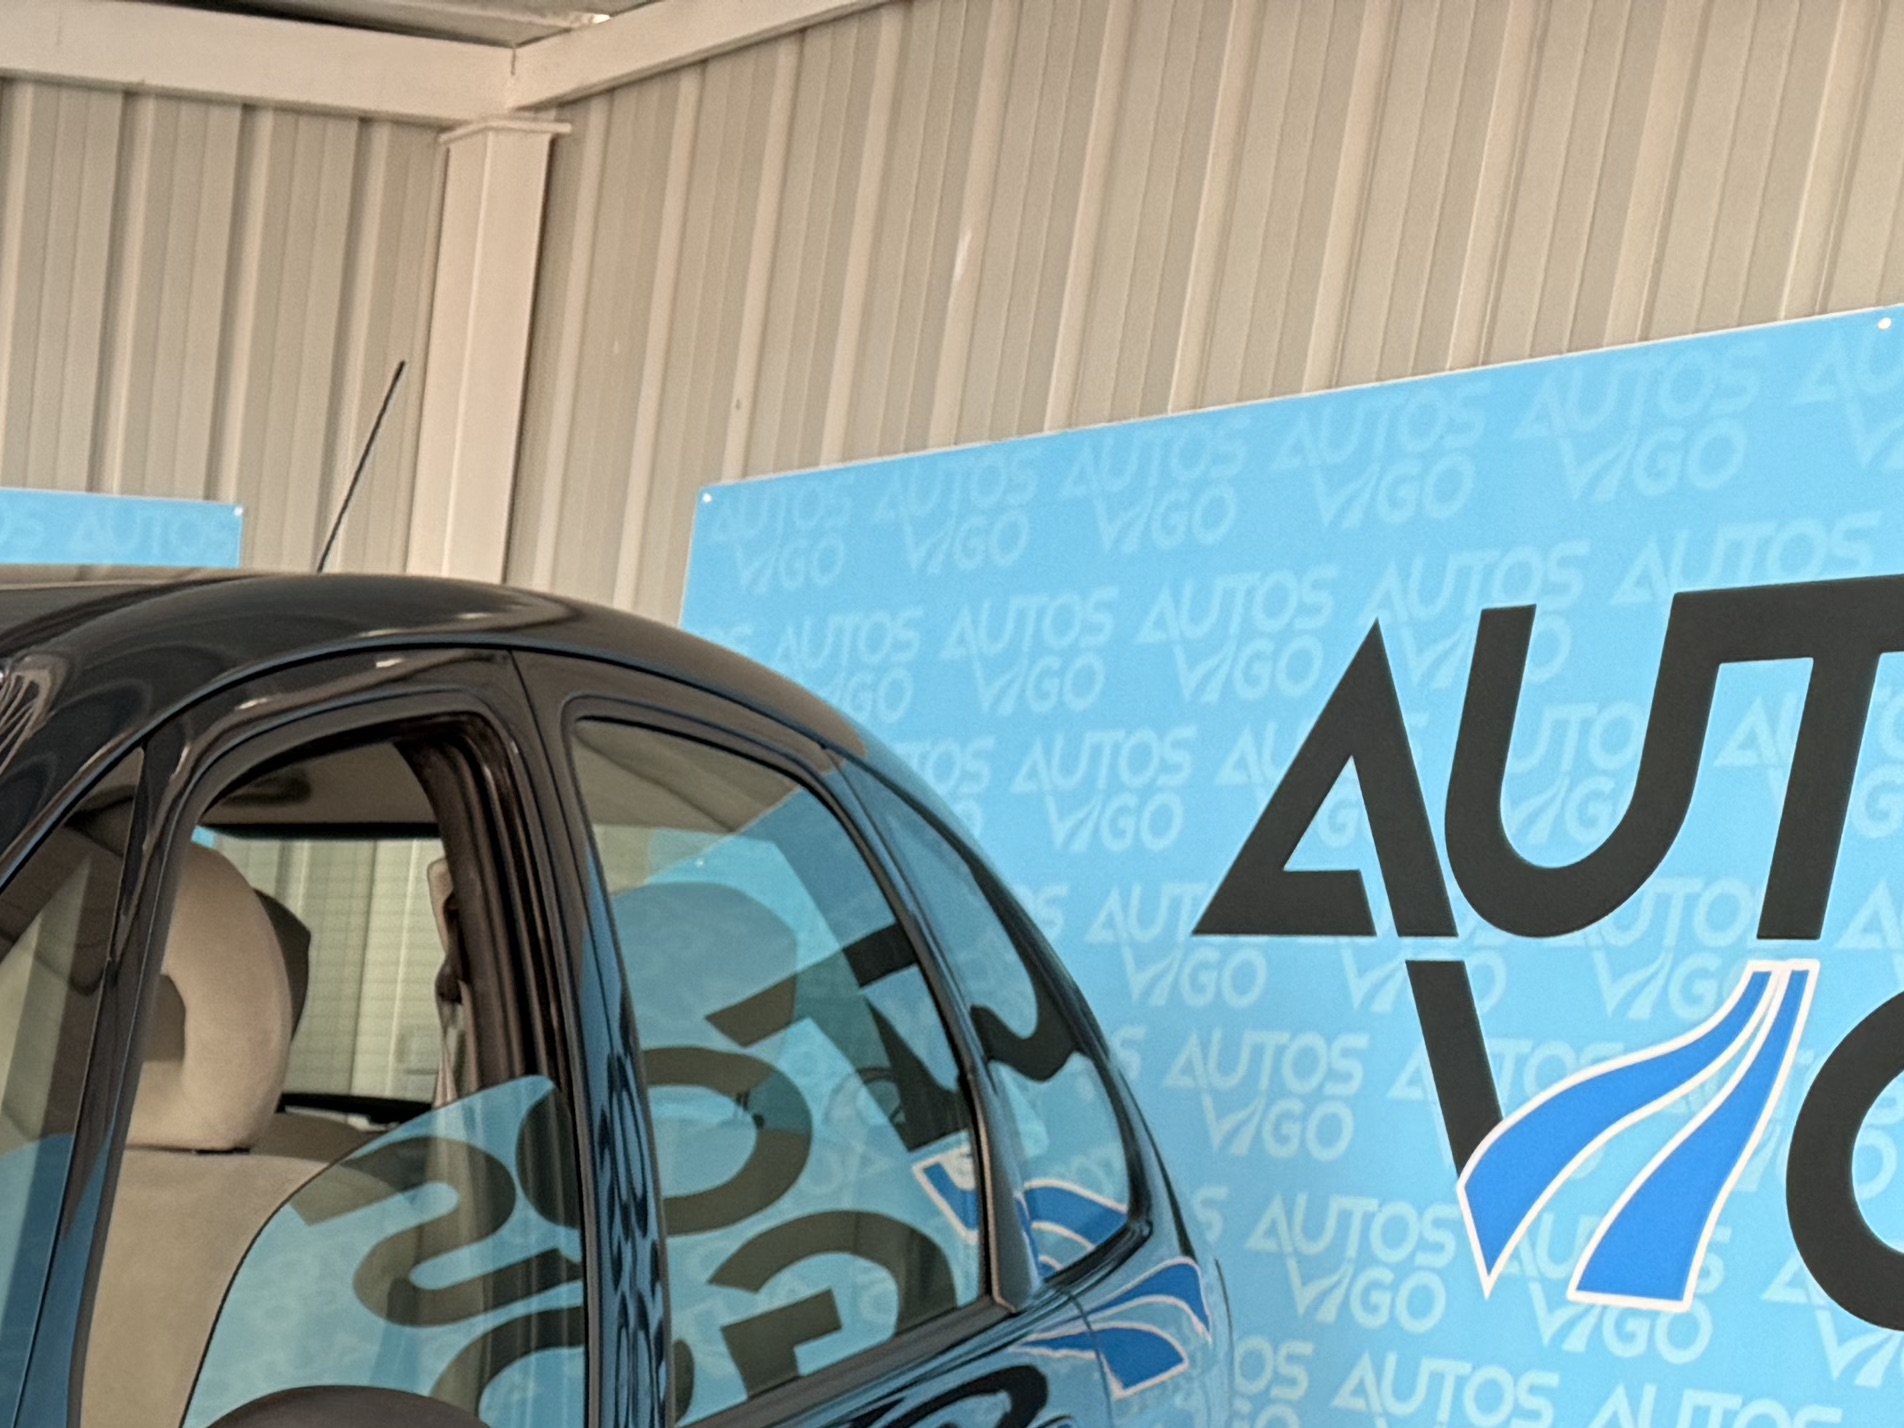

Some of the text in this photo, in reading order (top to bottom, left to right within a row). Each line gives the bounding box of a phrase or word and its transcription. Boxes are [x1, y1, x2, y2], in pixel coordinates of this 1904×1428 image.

[1268, 380, 1490, 473] AUTOS
[1510, 339, 1766, 442] AUTOS
[870, 446, 1041, 525] AUTOS
[1057, 415, 1251, 501] AUTOS
[704, 473, 856, 546] AUTOS
[939, 588, 1118, 661] AUTOS
[1135, 567, 1338, 645] AUTOS
[1010, 727, 1198, 794] AUTOS
[1191, 570, 1904, 940] AUT
[1163, 1028, 1370, 1096] AUTOS
[1246, 1192, 1462, 1267] AUTOS
